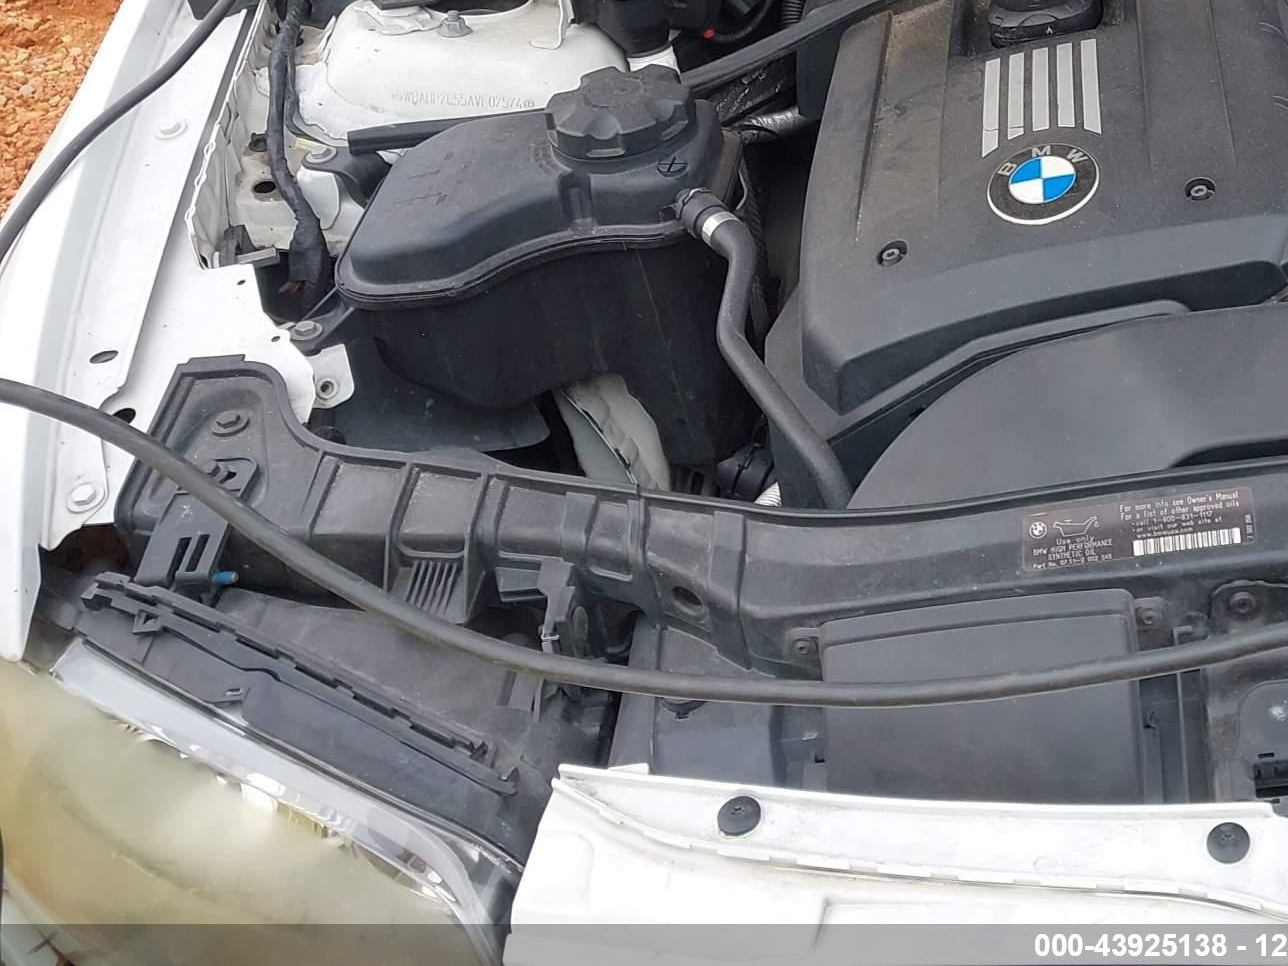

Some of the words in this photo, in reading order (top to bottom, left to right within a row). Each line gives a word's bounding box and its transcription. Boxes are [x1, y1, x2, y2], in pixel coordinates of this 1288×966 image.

[998, 144, 1089, 177] BMW
[1120, 504, 1132, 513] For
[1155, 500, 1168, 508] info
[1186, 494, 1213, 504] Owner's
[1216, 490, 1239, 501] Manual
[1120, 512, 1132, 521] For
[1143, 510, 1156, 518] list
[1170, 506, 1189, 514] other
[1192, 502, 1223, 512] approved
[1226, 500, 1240, 508] oils
[1148, 523, 1164, 531] visit
[1032, 548, 1048, 556] BMW
[1050, 545, 1066, 554] HIGH
[1068, 538, 1113, 551] PERFORMANCE
[1076, 534, 1094, 542] only
[1048, 551, 1082, 560] SYNTHETIC
